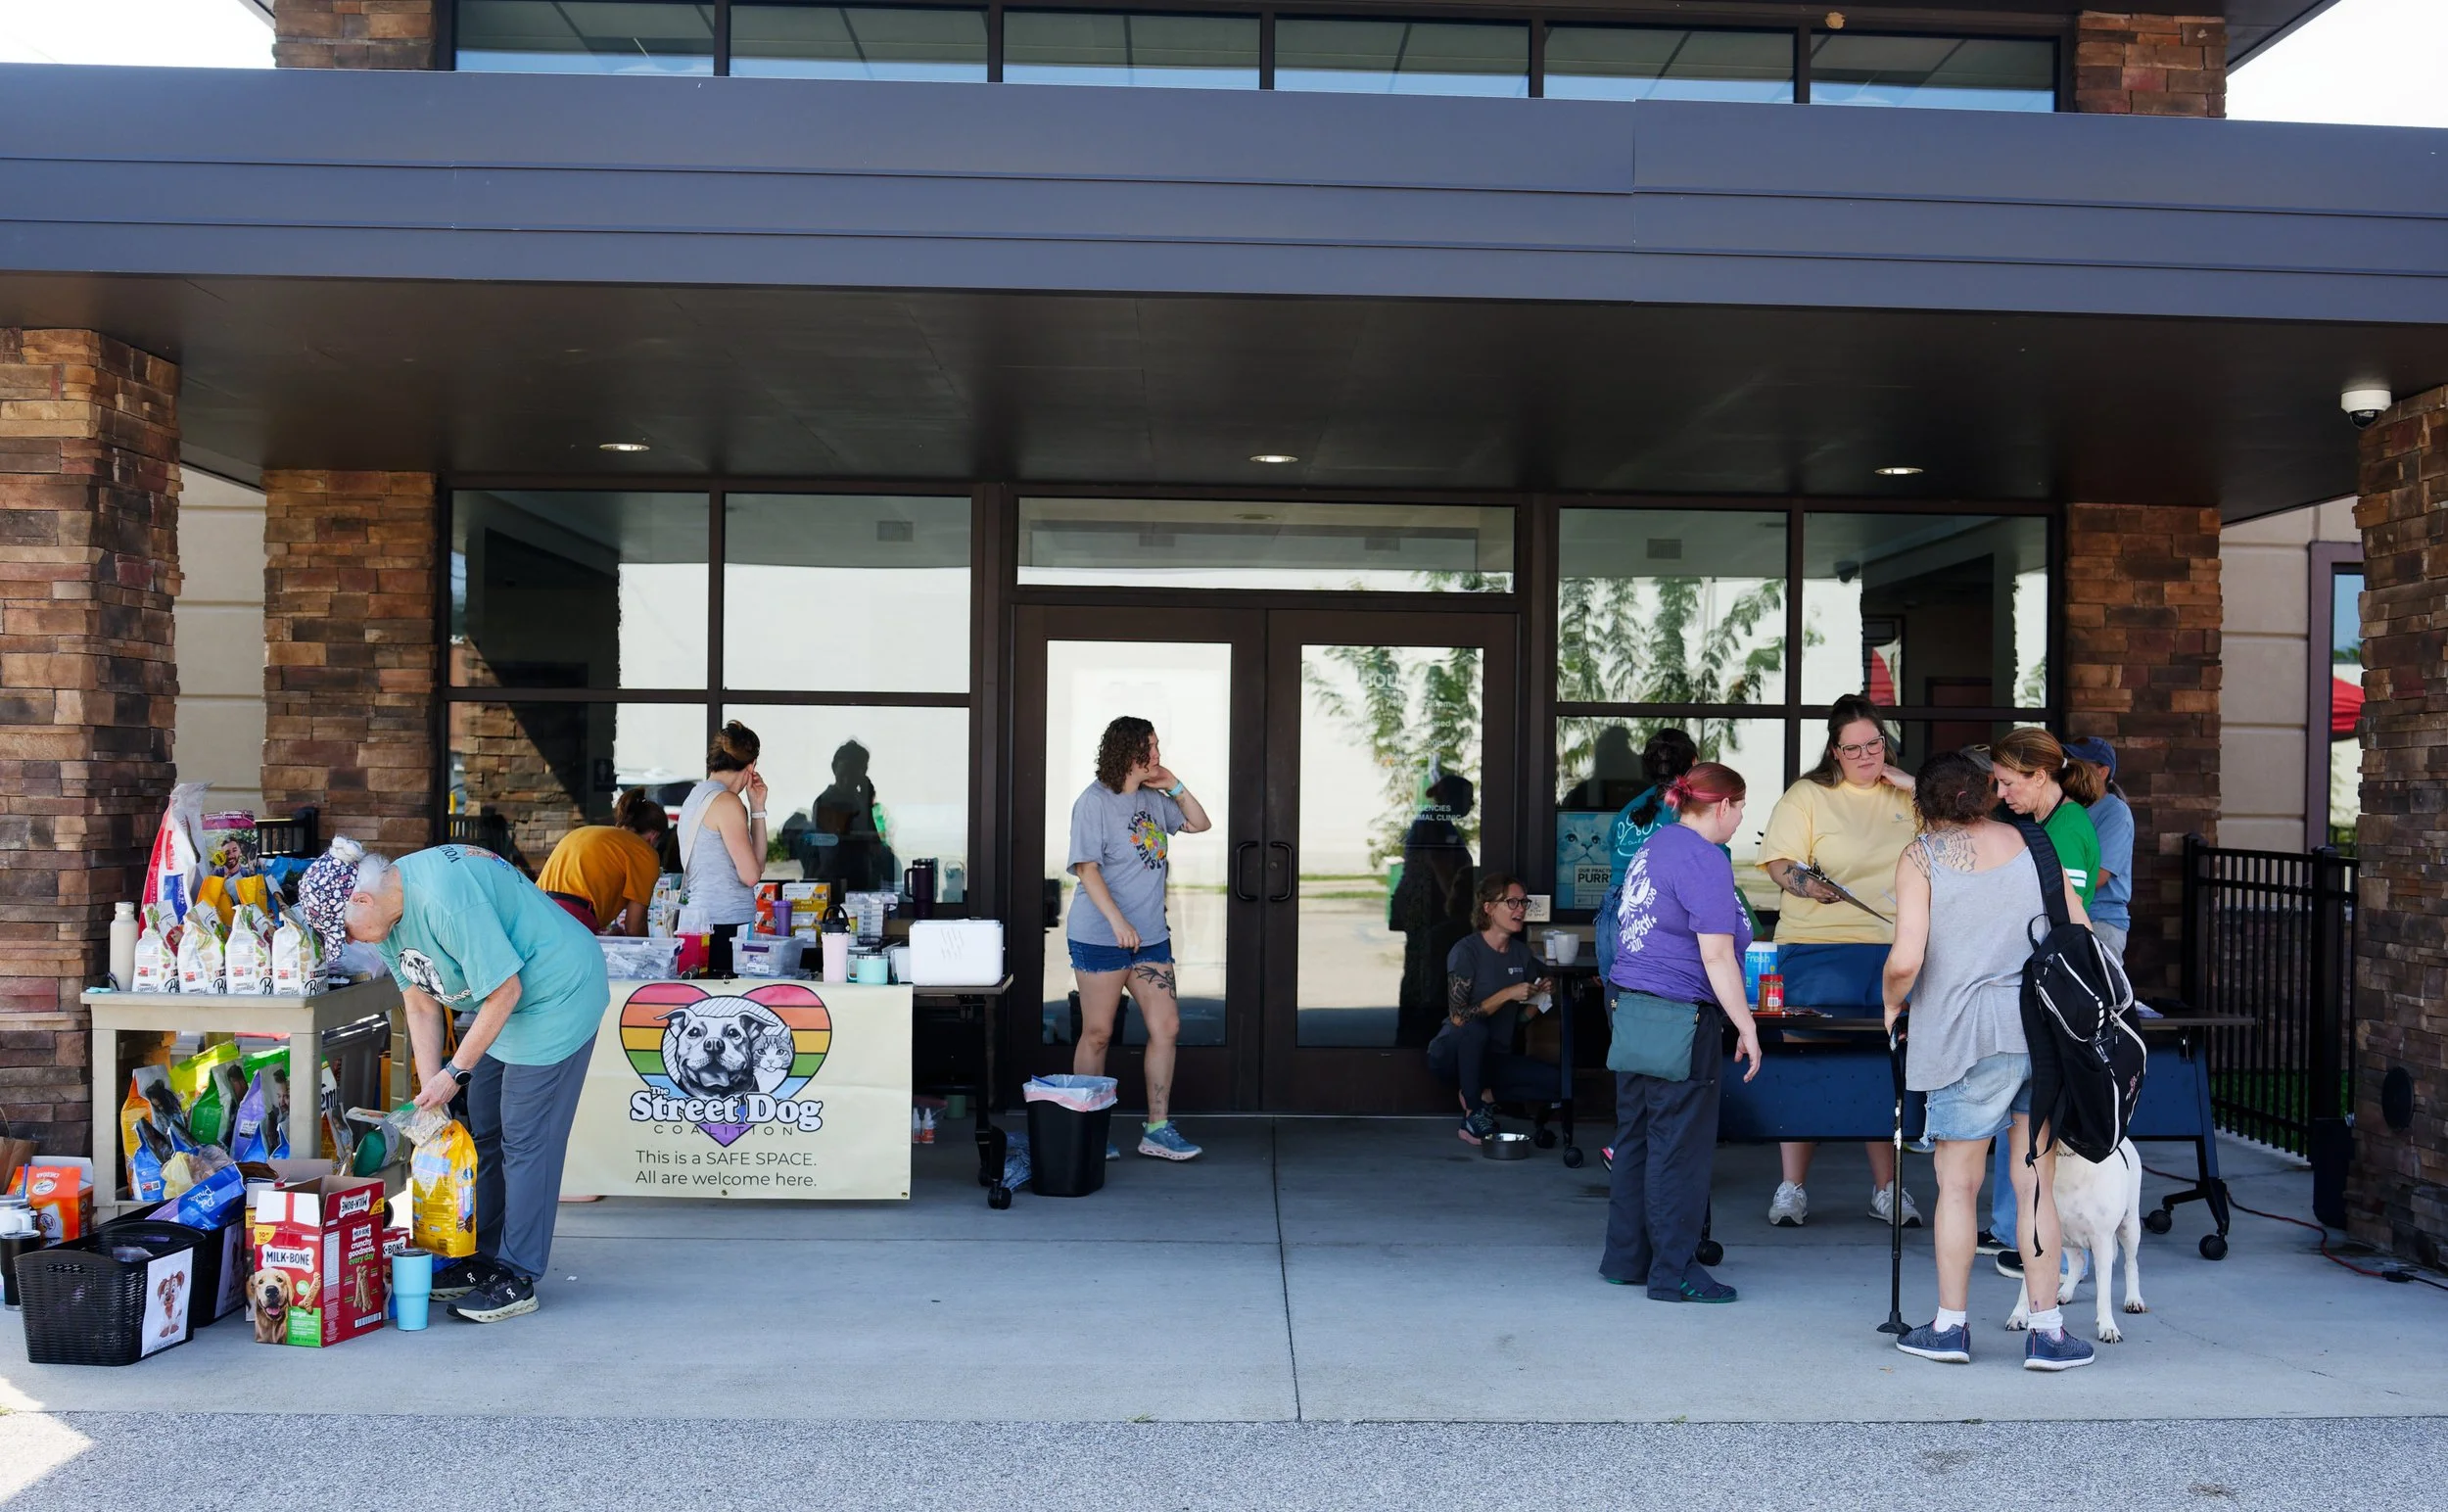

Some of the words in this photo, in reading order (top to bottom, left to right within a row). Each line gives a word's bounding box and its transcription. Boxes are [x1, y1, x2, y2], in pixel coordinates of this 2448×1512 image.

[1745, 953, 1770, 963] Fresh
[650, 1086, 670, 1096] The
[631, 1090, 743, 1123] Street
[744, 1092, 824, 1132] Dog
[653, 1124, 793, 1136] COALITION
[636, 1150, 670, 1164] This
[675, 1151, 687, 1164] is
[691, 1155, 701, 1165] a
[706, 1152, 750, 1165] SAFE
[755, 1153, 818, 1166] SPACE.
[636, 1170, 656, 1184] All
[661, 1174, 688, 1185] are
[691, 1172, 770, 1186] welcome
[776, 1172, 818, 1187] here.
[351, 1238, 373, 1249] crunchy
[348, 1247, 376, 1260] goodness,
[349, 1255, 363, 1266] every
[364, 1253, 375, 1263] day
